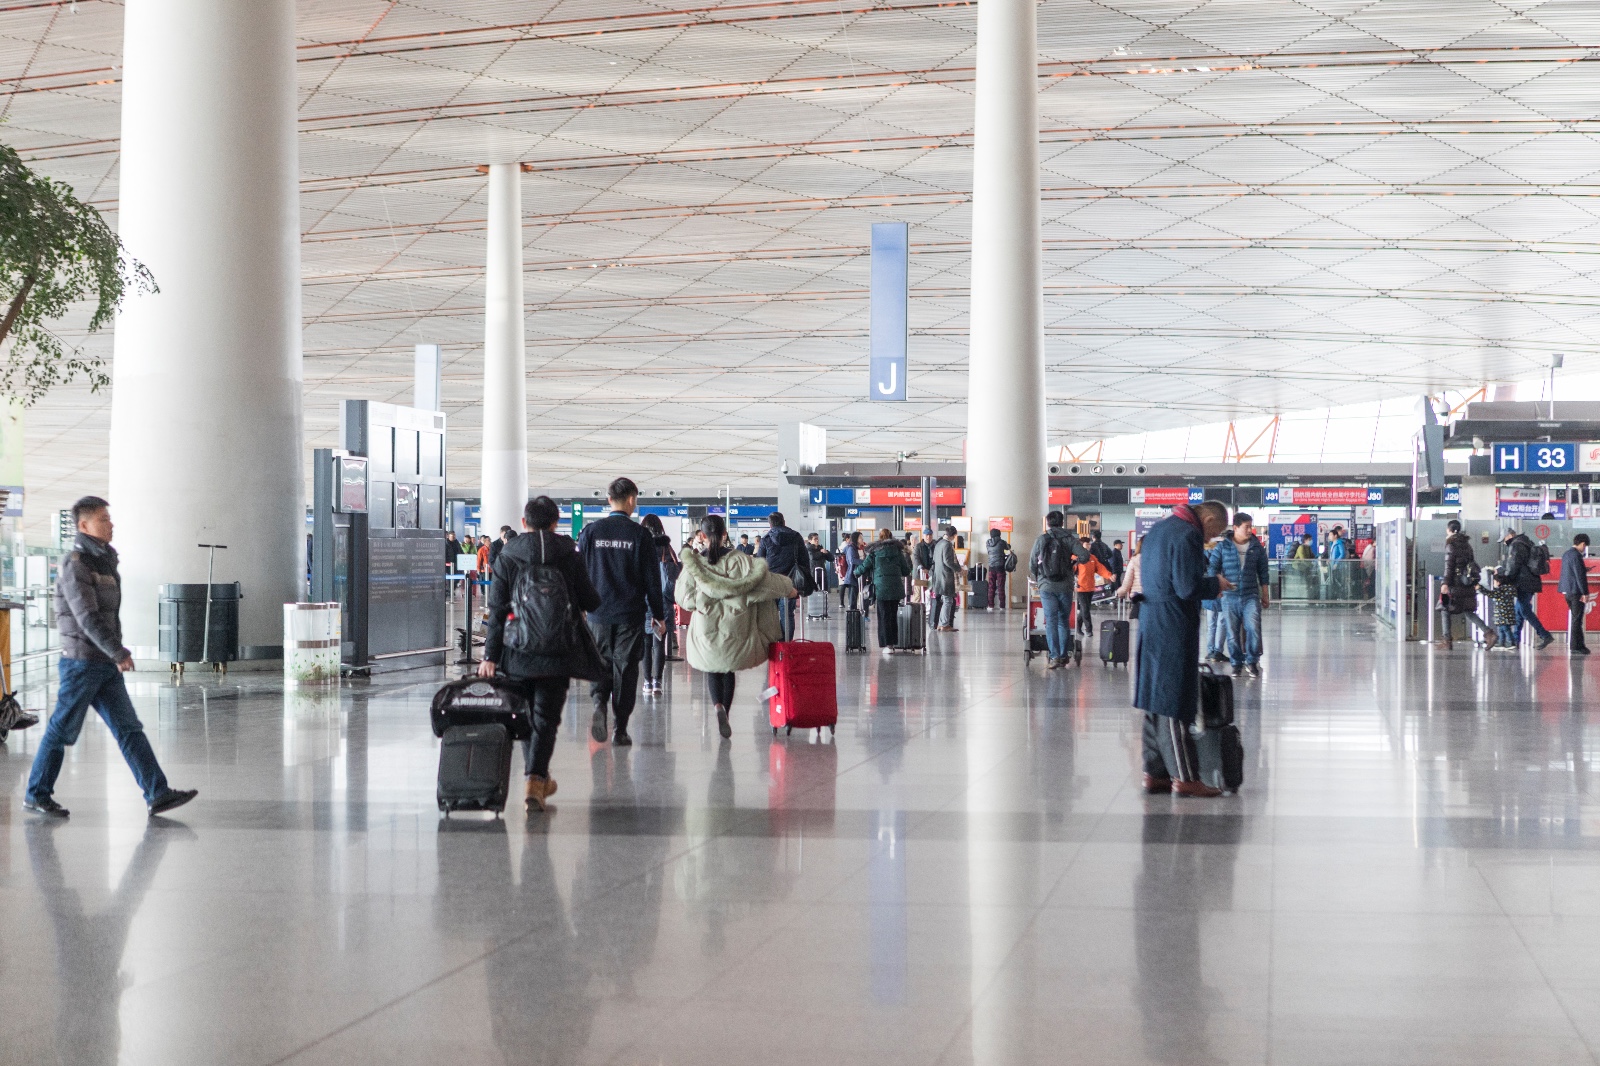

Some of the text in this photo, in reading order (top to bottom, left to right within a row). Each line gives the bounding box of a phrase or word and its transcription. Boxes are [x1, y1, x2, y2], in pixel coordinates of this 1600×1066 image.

[879, 362, 897, 395] J
[1500, 447, 1566, 470] H 33
[814, 490, 823, 503] J
[1189, 492, 1203, 500] J32
[1265, 492, 1278, 500] J31
[1367, 492, 1381, 500] J30
[1281, 524, 1306, 536] 仅限
[595, 540, 633, 550] SECURITY
